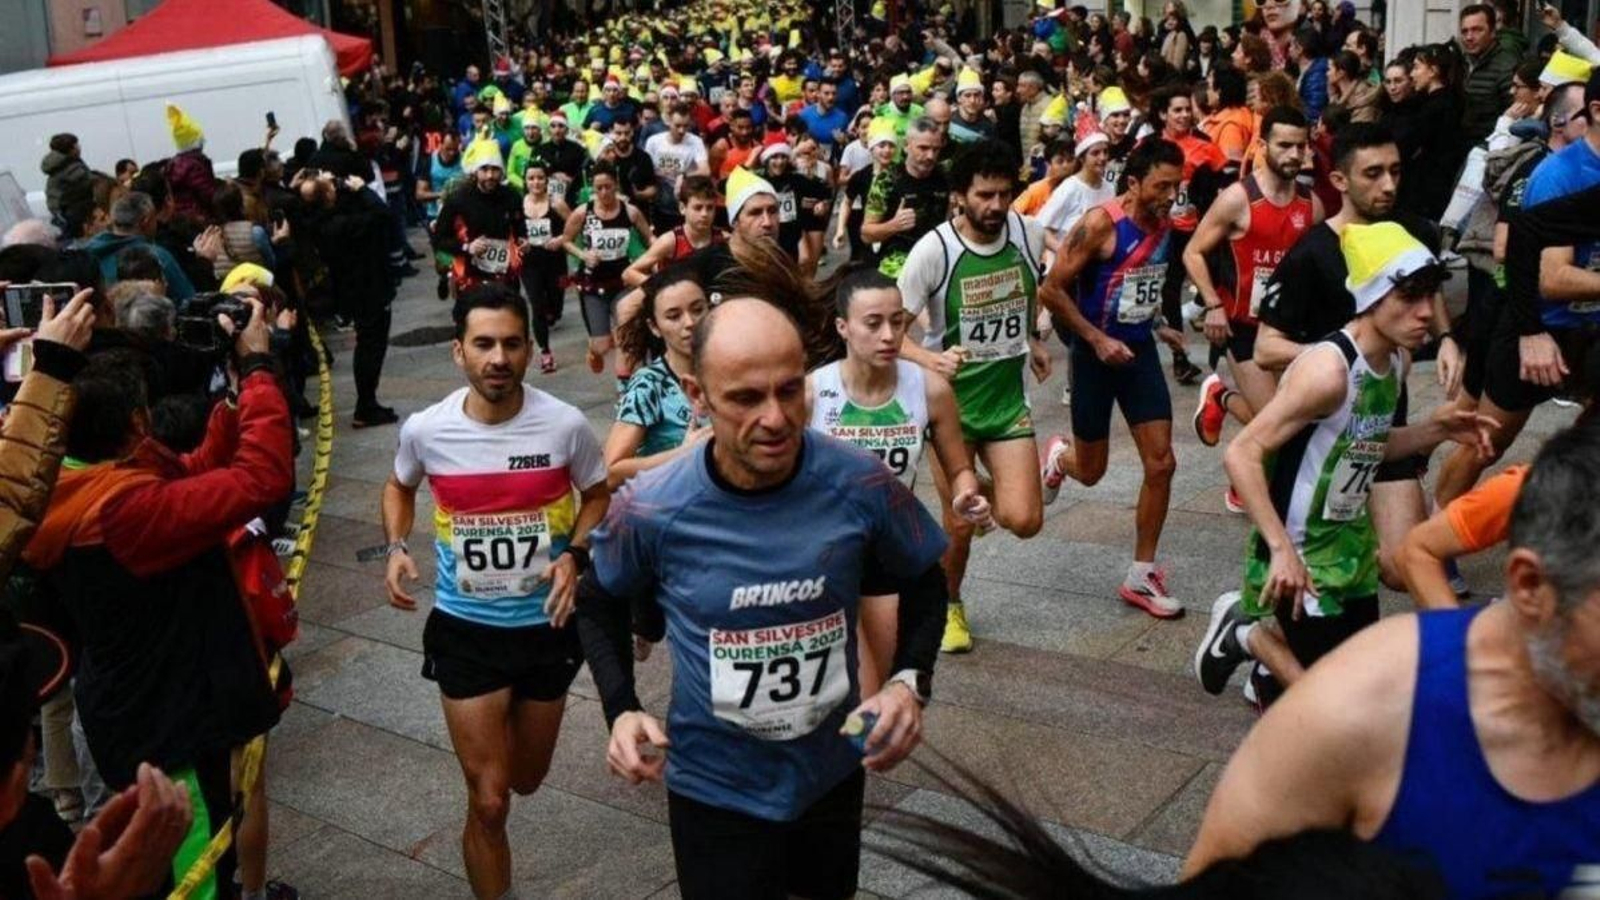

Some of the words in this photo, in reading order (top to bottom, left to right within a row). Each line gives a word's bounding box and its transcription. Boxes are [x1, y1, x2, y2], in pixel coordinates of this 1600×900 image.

[597, 237, 625, 250] 207
[1135, 280, 1160, 304] 56
[969, 315, 1020, 343] 478
[831, 427, 855, 437] SAN
[858, 426, 917, 437] SILVESTRE
[892, 436, 917, 447] 2022
[509, 454, 550, 470] 226ERS
[452, 516, 476, 526] SAN
[479, 513, 543, 526] SILVESTRE
[453, 526, 513, 537] OURENSA
[517, 523, 547, 536] 2022
[464, 535, 539, 571] 607
[730, 576, 826, 610] BRINCOS
[712, 631, 750, 646] SAN
[755, 615, 843, 642] SILVESTRE
[713, 640, 804, 661] OURENSA
[809, 628, 844, 649] 2022
[733, 647, 832, 709] 737
